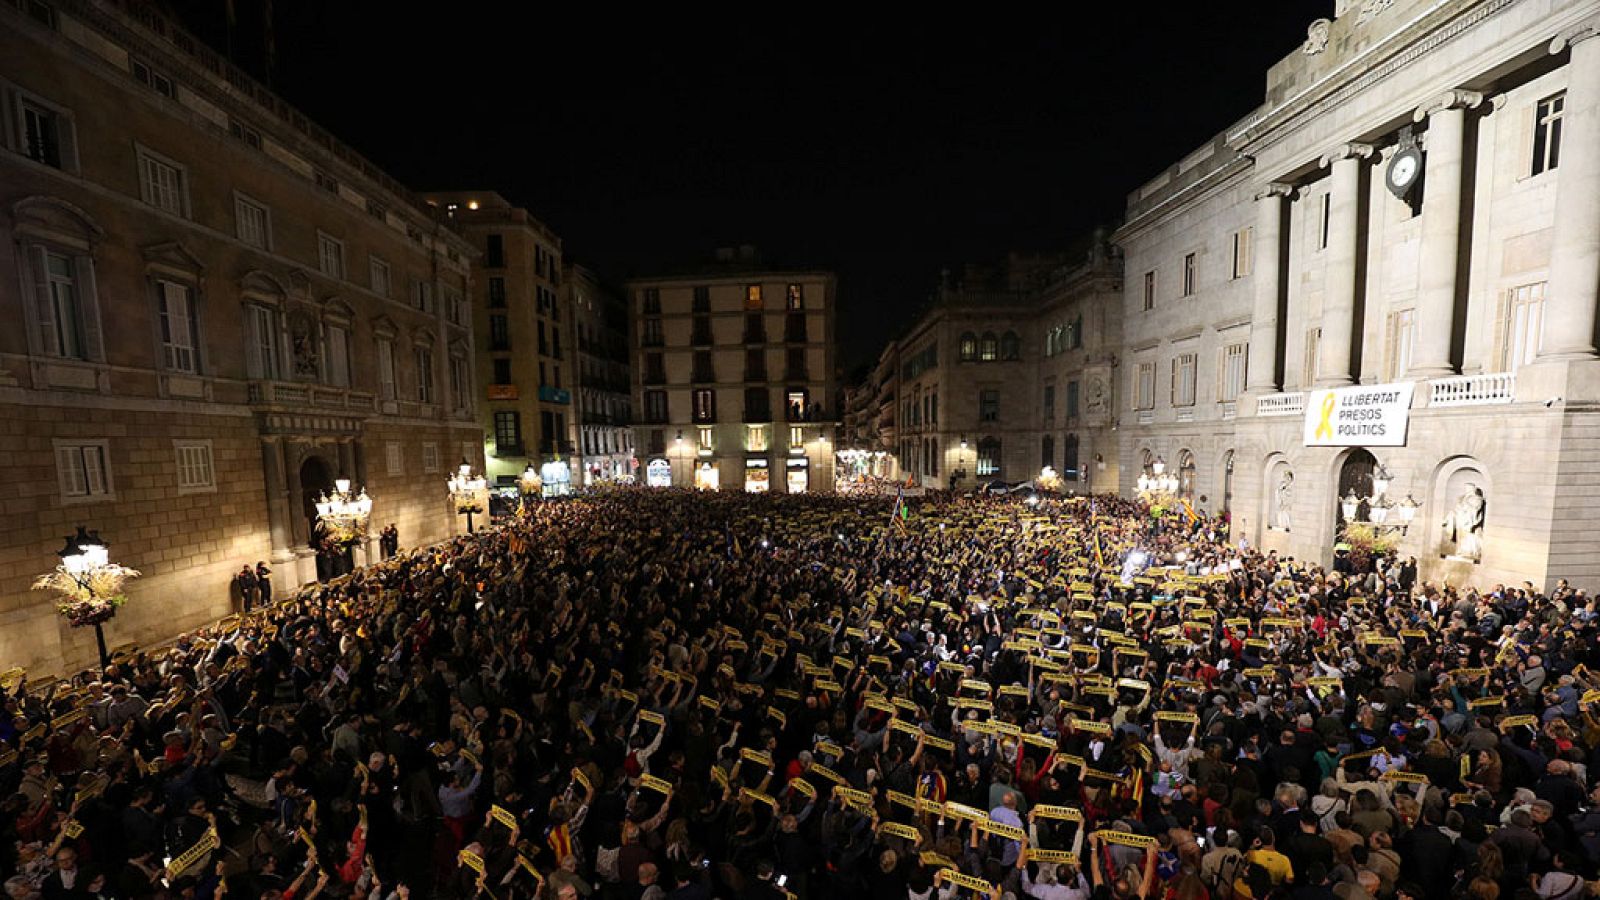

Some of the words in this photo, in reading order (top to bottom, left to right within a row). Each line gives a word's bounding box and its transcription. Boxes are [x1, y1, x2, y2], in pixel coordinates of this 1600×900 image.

[1341, 391, 1401, 406] LLIBERTAT
[1338, 408, 1382, 421] PRESOS
[1338, 421, 1386, 436] POLÍTICS
